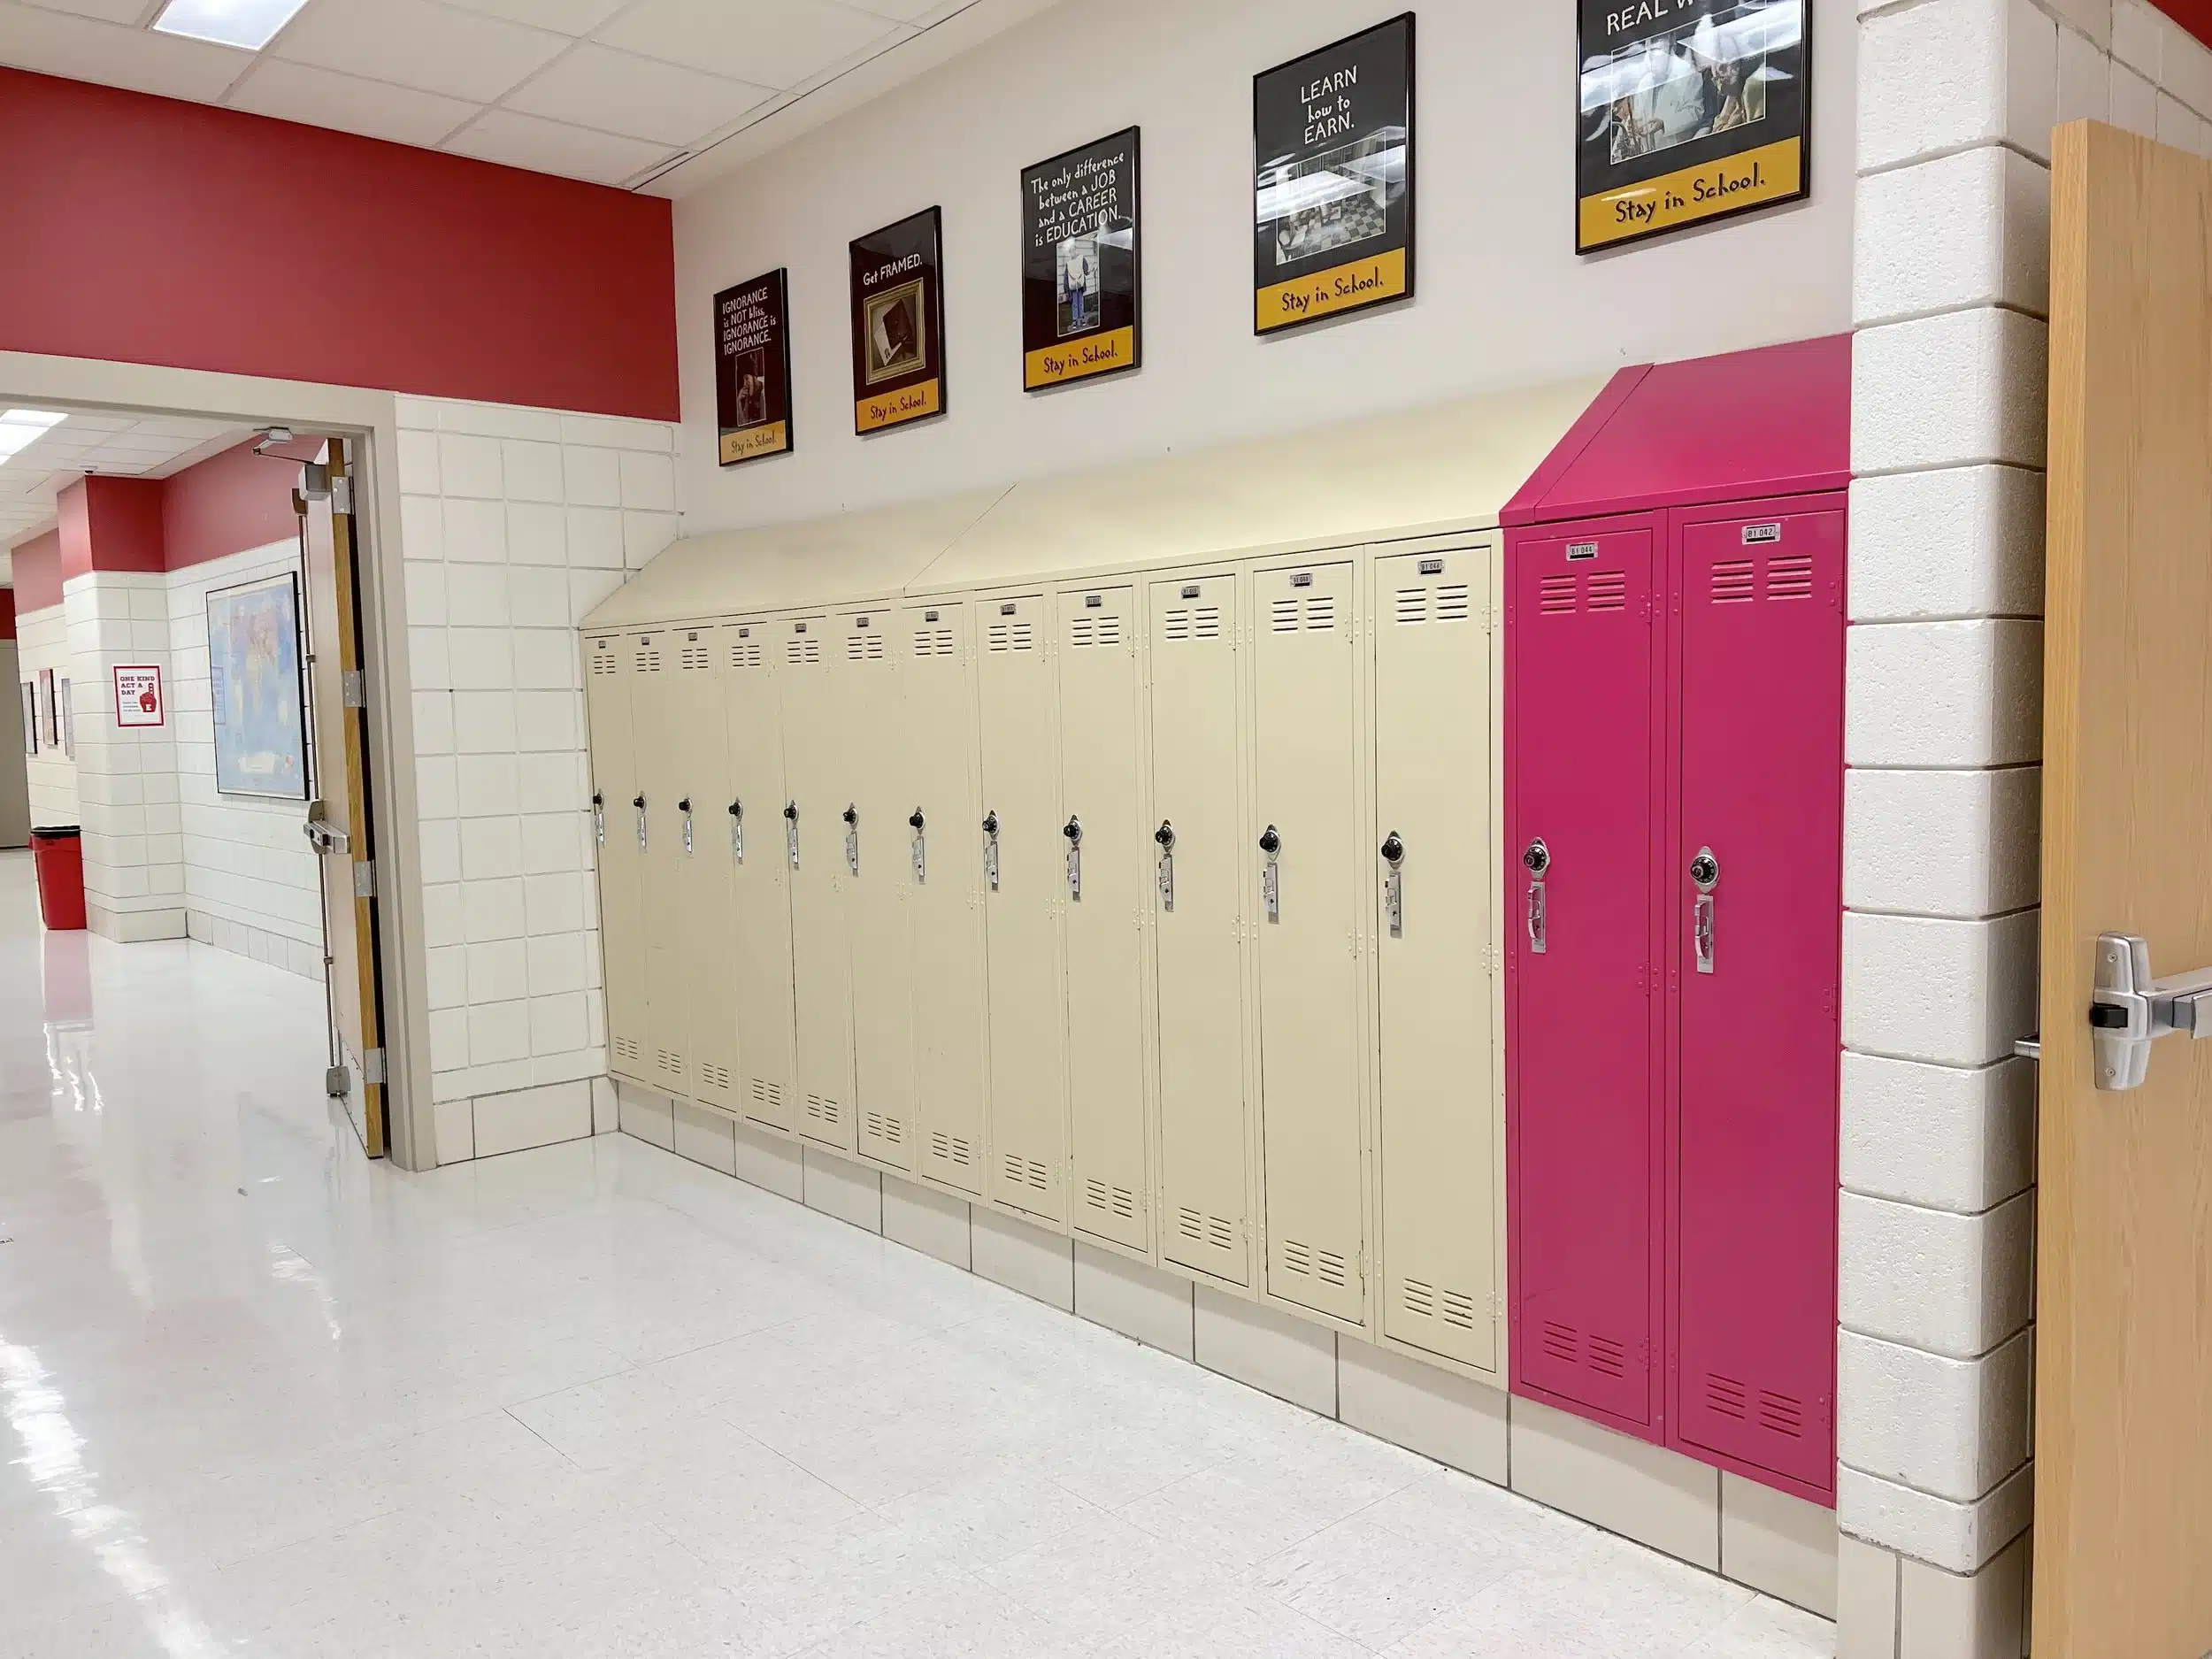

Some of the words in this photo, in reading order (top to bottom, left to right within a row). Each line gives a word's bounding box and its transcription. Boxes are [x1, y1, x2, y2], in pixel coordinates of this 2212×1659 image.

[1606, 0, 1669, 35] REAL
[1301, 65, 1358, 104] LEARN
[1308, 103, 1333, 123] how
[1337, 95, 1351, 111] to
[1304, 111, 1355, 145] EARN.
[1031, 177, 1048, 194] The
[1051, 167, 1071, 188] only
[1074, 152, 1124, 179] difference
[1039, 189, 1079, 211] between
[1081, 185, 1088, 195] a
[1091, 169, 1116, 192] JOB
[1039, 209, 1055, 228] and
[1059, 211, 1065, 221] a
[1069, 187, 1117, 217] CAREER
[1616, 200, 1656, 224] Stay
[1664, 190, 1685, 210] in
[1693, 161, 1766, 203] School.
[1036, 234, 1043, 247] is
[1046, 204, 1121, 243] EDUCATION.
[863, 272, 878, 286] Get
[880, 253, 923, 280] FRAMED.
[723, 287, 768, 314] IGNORANCE
[1282, 290, 1310, 312] Stay
[1316, 286, 1329, 303] in
[1334, 266, 1384, 297] School.
[723, 318, 730, 328] is
[731, 308, 747, 325] NOT
[723, 315, 769, 342] IGNORANCE
[770, 315, 777, 327] is
[724, 329, 772, 356] IGNORANCE.
[1044, 356, 1065, 375] Stay
[1068, 353, 1079, 368] in
[1082, 339, 1118, 365] School.
[870, 403, 887, 421] Stay
[888, 402, 897, 415] in
[899, 390, 926, 412] School.
[731, 440, 744, 457] Stay
[746, 437, 753, 449] in
[755, 429, 777, 448] School.
